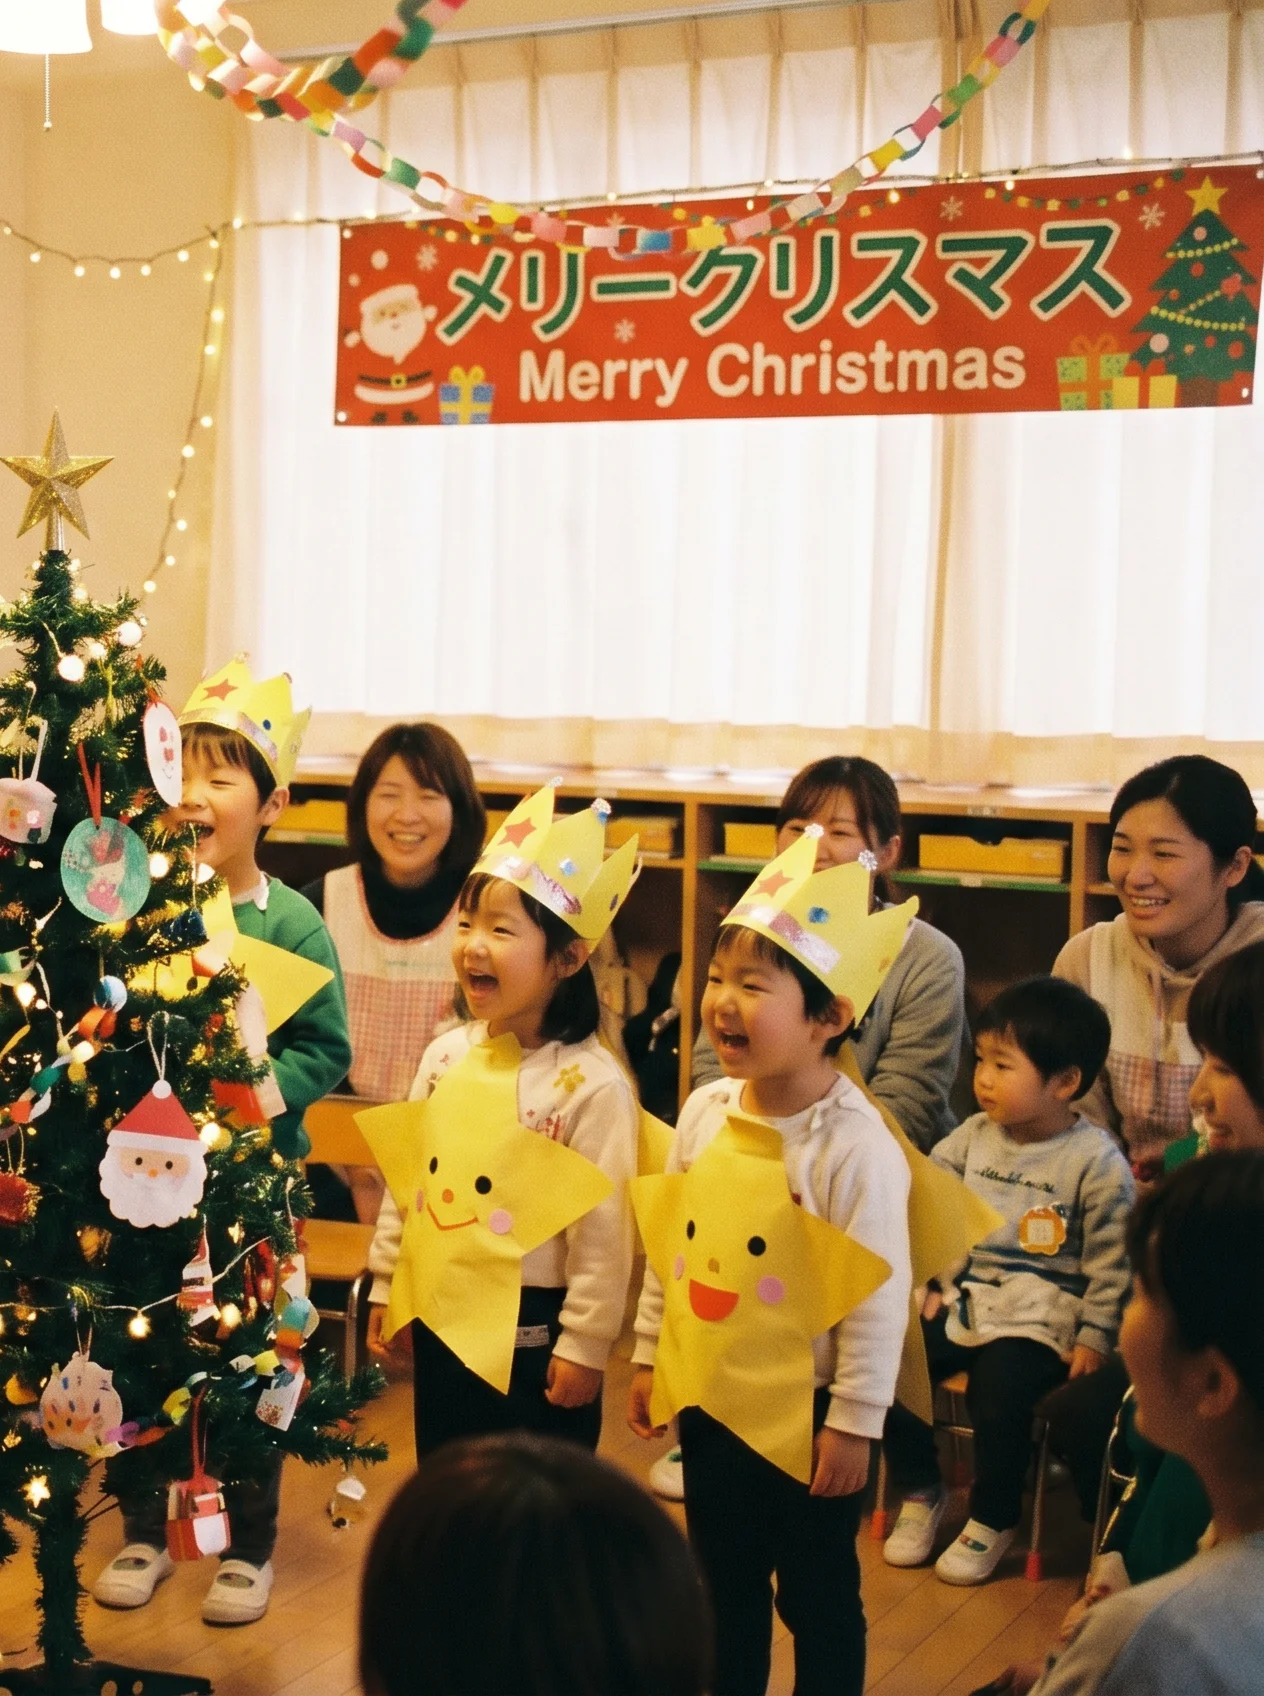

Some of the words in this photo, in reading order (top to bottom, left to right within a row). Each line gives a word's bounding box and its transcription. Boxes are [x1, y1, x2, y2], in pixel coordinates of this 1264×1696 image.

[436, 218, 1133, 346] メリークリスマス
[519, 348, 690, 408] Merry
[706, 338, 1027, 398] Christmas
